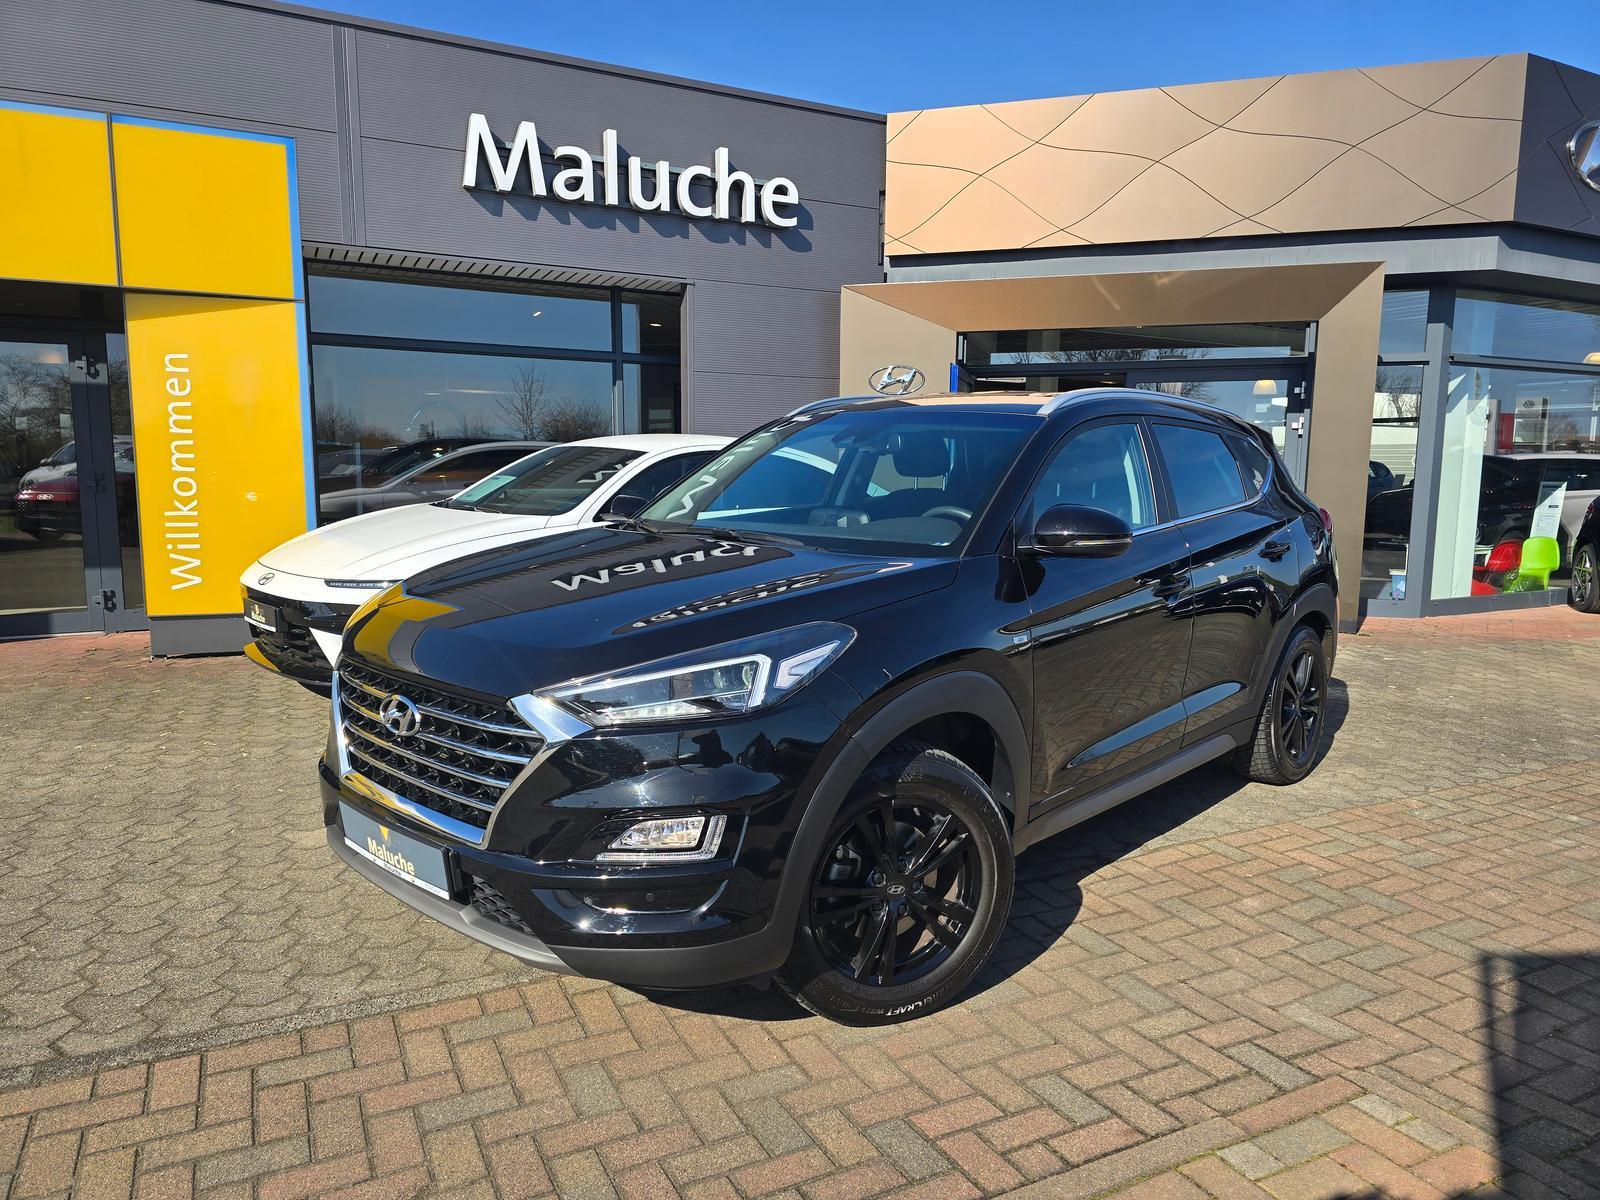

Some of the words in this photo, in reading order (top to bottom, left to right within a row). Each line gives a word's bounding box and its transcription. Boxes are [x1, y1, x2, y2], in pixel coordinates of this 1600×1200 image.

[462, 112, 799, 228] Maluche
[164, 353, 202, 590] Willkommen
[367, 836, 415, 876] Maluche
